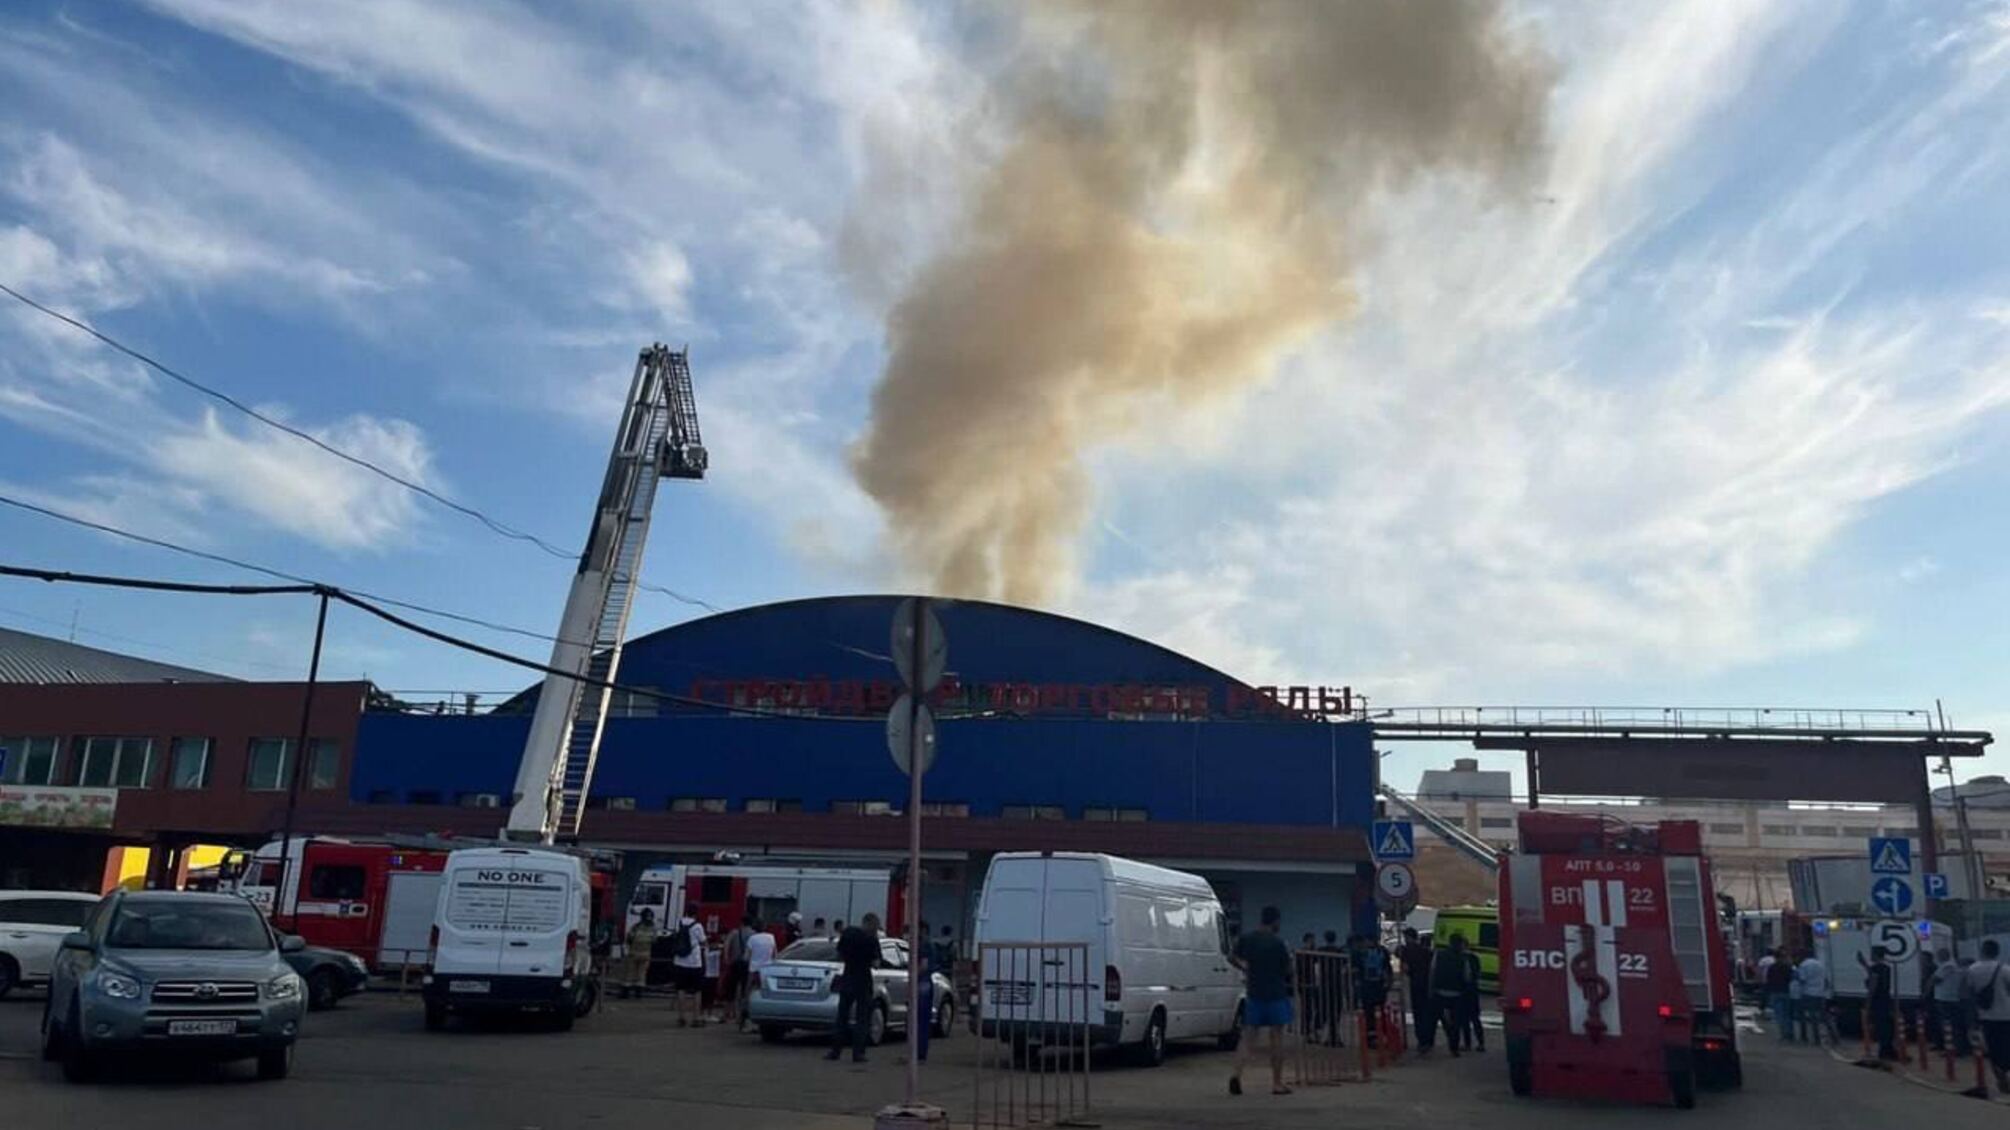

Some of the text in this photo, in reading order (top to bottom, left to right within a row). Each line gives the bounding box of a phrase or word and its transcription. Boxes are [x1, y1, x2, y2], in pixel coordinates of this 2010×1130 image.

[689, 677, 964, 713] СТРОЙДВР
[1224, 686, 1351, 715] РЯДЫ
[478, 870, 546, 883] NO ONE
[1391, 872, 1402, 888] 5
[1930, 875, 1943, 896] P
[1631, 888, 1655, 904] 22
[1882, 925, 1907, 956] 5
[1514, 950, 1650, 971] БЛС 22
